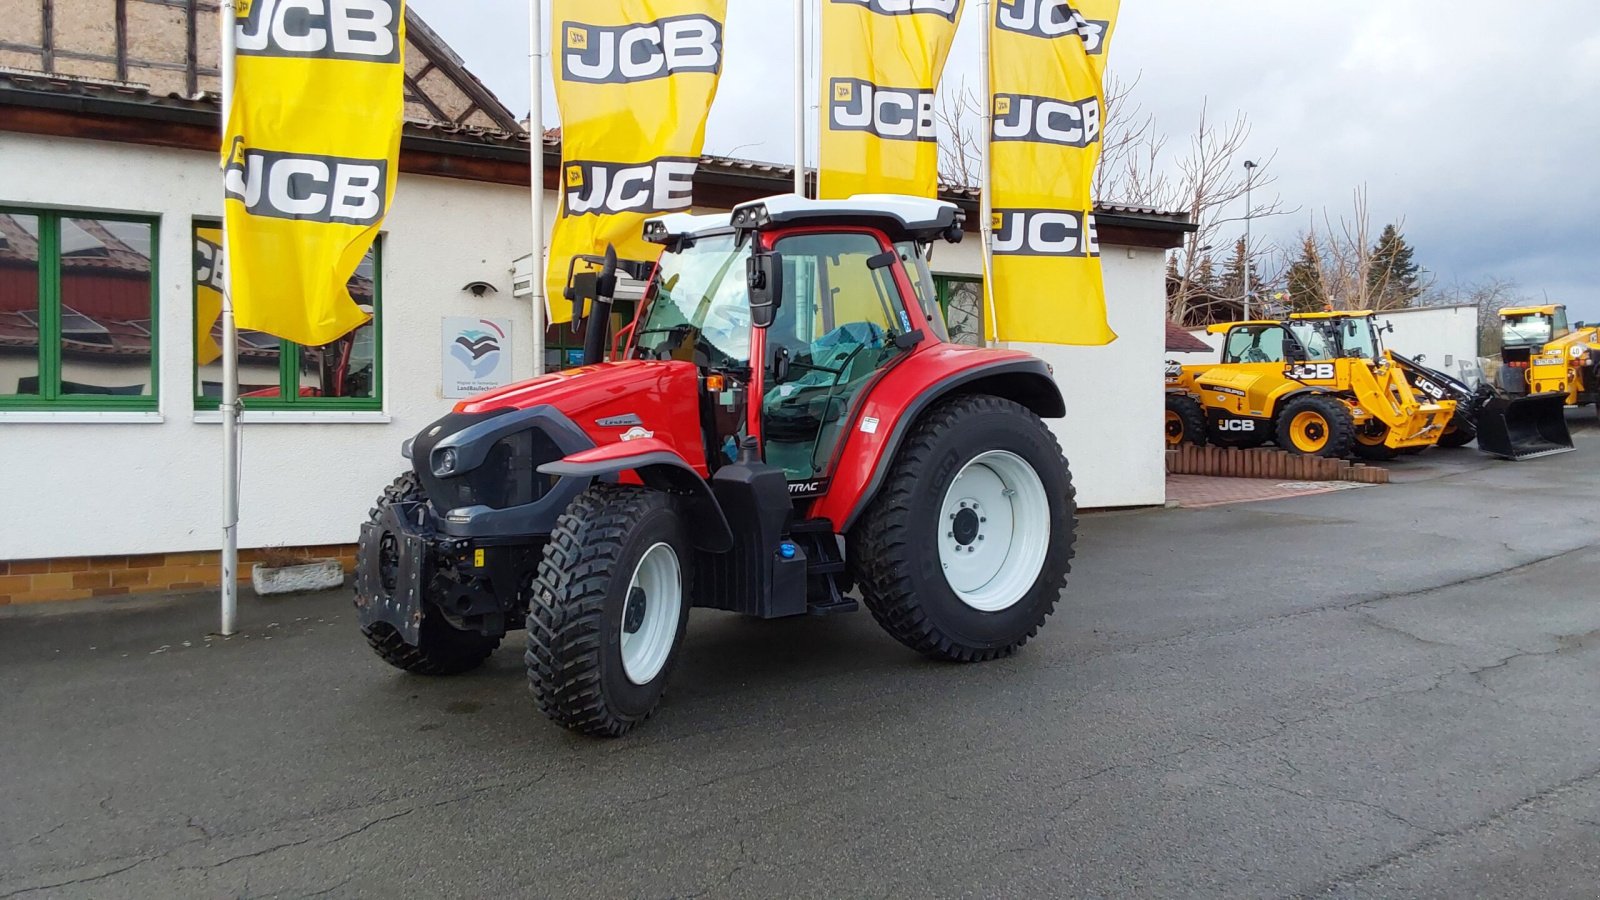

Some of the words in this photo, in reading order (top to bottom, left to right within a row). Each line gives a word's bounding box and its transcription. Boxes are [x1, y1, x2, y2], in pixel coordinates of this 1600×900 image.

[236, 0, 394, 56] JCB
[567, 19, 719, 79] JCB
[834, 84, 937, 137] JCB
[993, 98, 1100, 144] JCB
[225, 154, 381, 219] JCB
[1414, 378, 1443, 399] JCB
[1218, 419, 1255, 431] JCB
